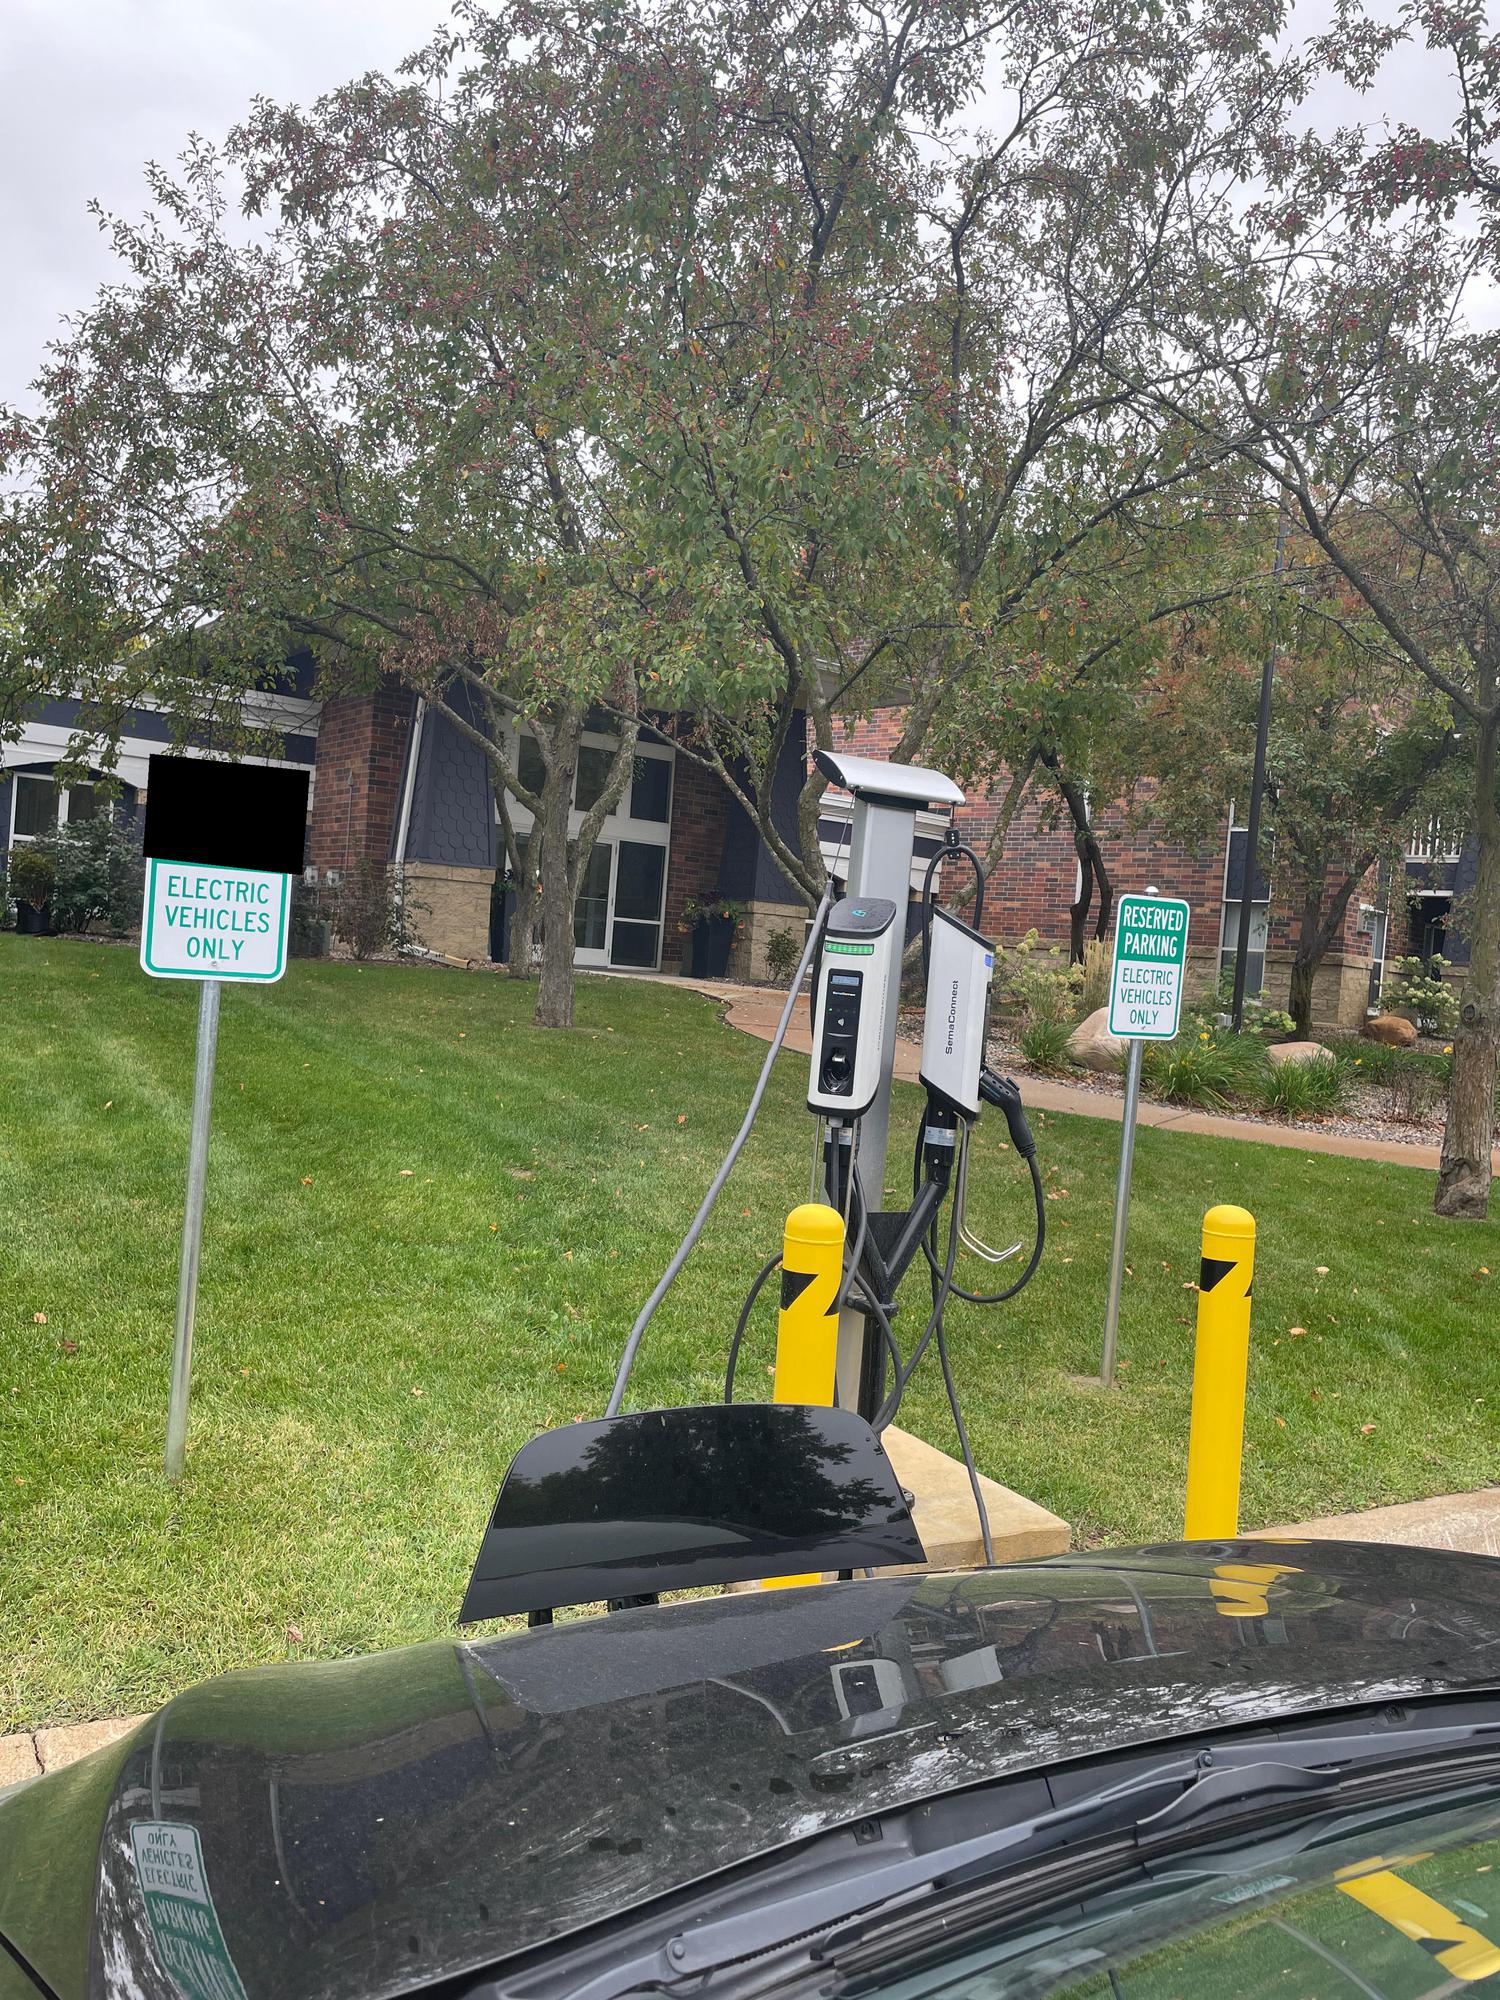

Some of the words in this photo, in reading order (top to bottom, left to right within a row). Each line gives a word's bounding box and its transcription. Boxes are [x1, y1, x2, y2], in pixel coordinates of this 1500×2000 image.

[168, 875, 270, 904] ELECTRIC
[165, 905, 270, 933] VEHICLES
[1123, 905, 1184, 931] RESERVED
[186, 936, 245, 960] ONLY
[1124, 933, 1178, 957] PARKING
[1122, 968, 1173, 985] ELECTRIC
[1121, 989, 1172, 1005] VEHICLES
[945, 980, 959, 1055] SemaConnect
[1130, 1009, 1159, 1025] ONLY
